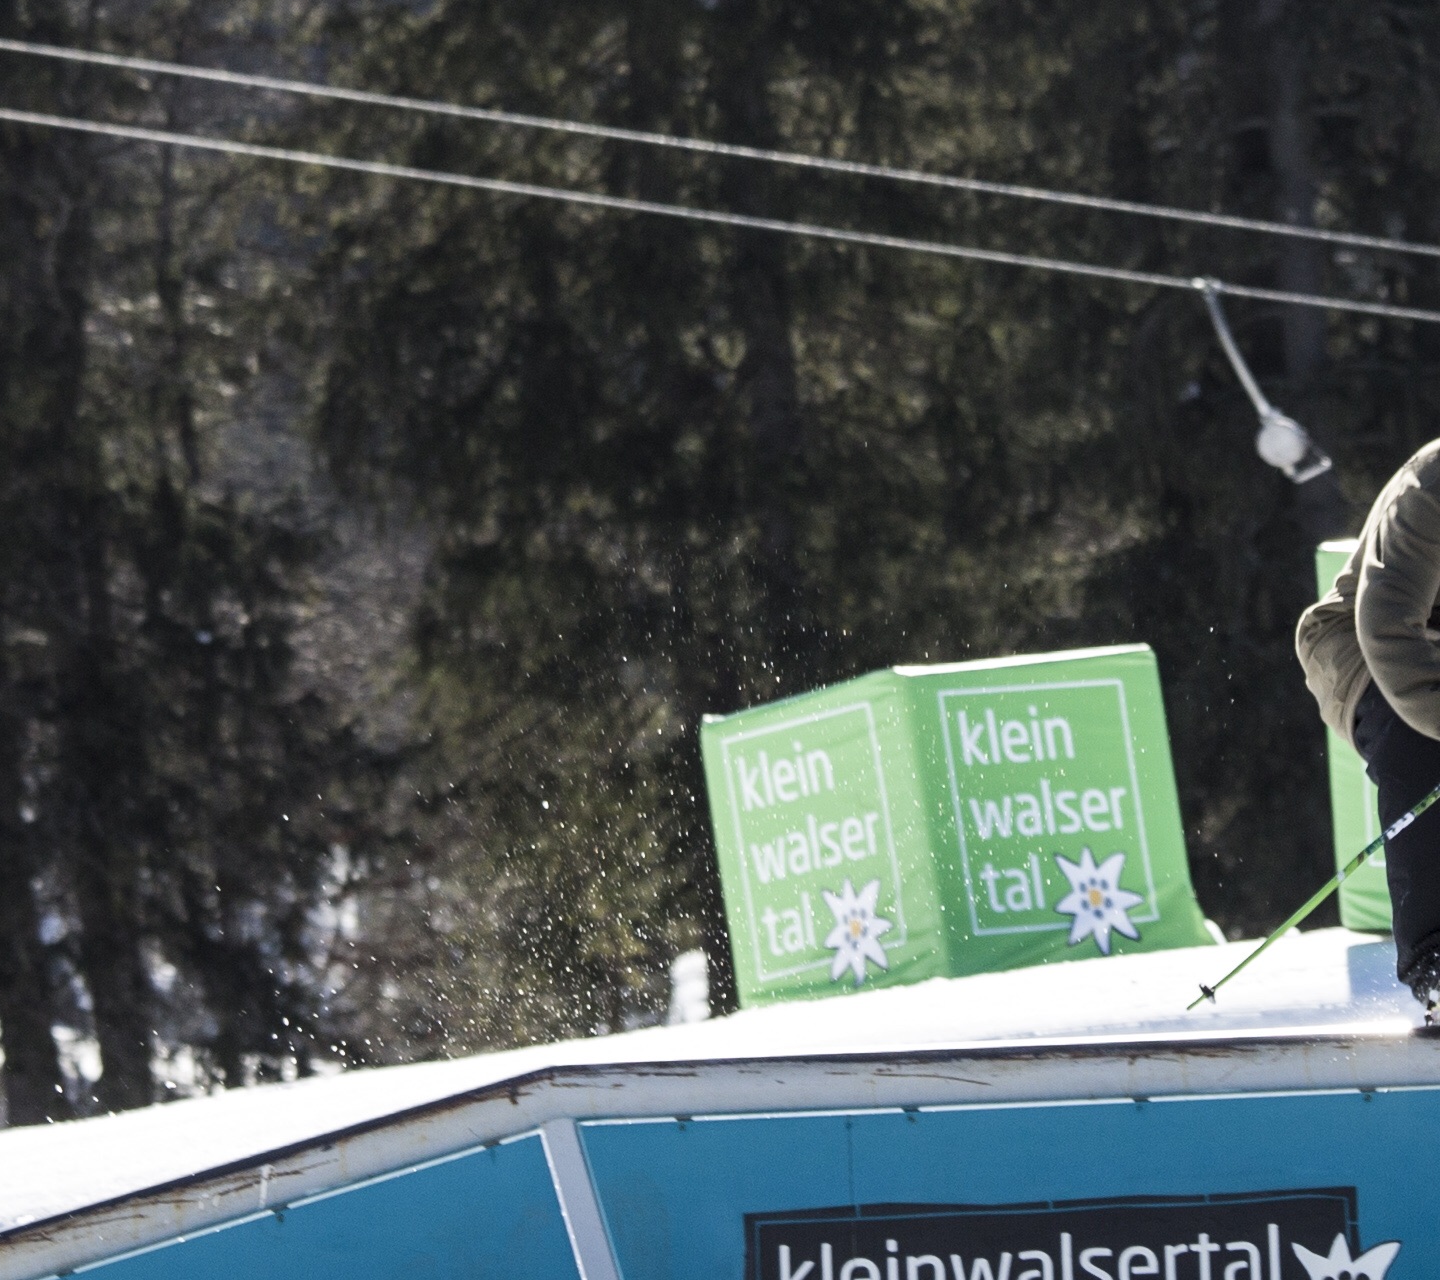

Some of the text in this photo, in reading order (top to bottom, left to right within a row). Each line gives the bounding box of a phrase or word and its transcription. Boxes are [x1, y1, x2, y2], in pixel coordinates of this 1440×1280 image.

[959, 706, 1075, 766] klein
[737, 742, 834, 812] klein
[969, 778, 1127, 840] walser
[750, 812, 879, 884] walser
[980, 854, 1046, 913] tal
[760, 893, 815, 956] tal
